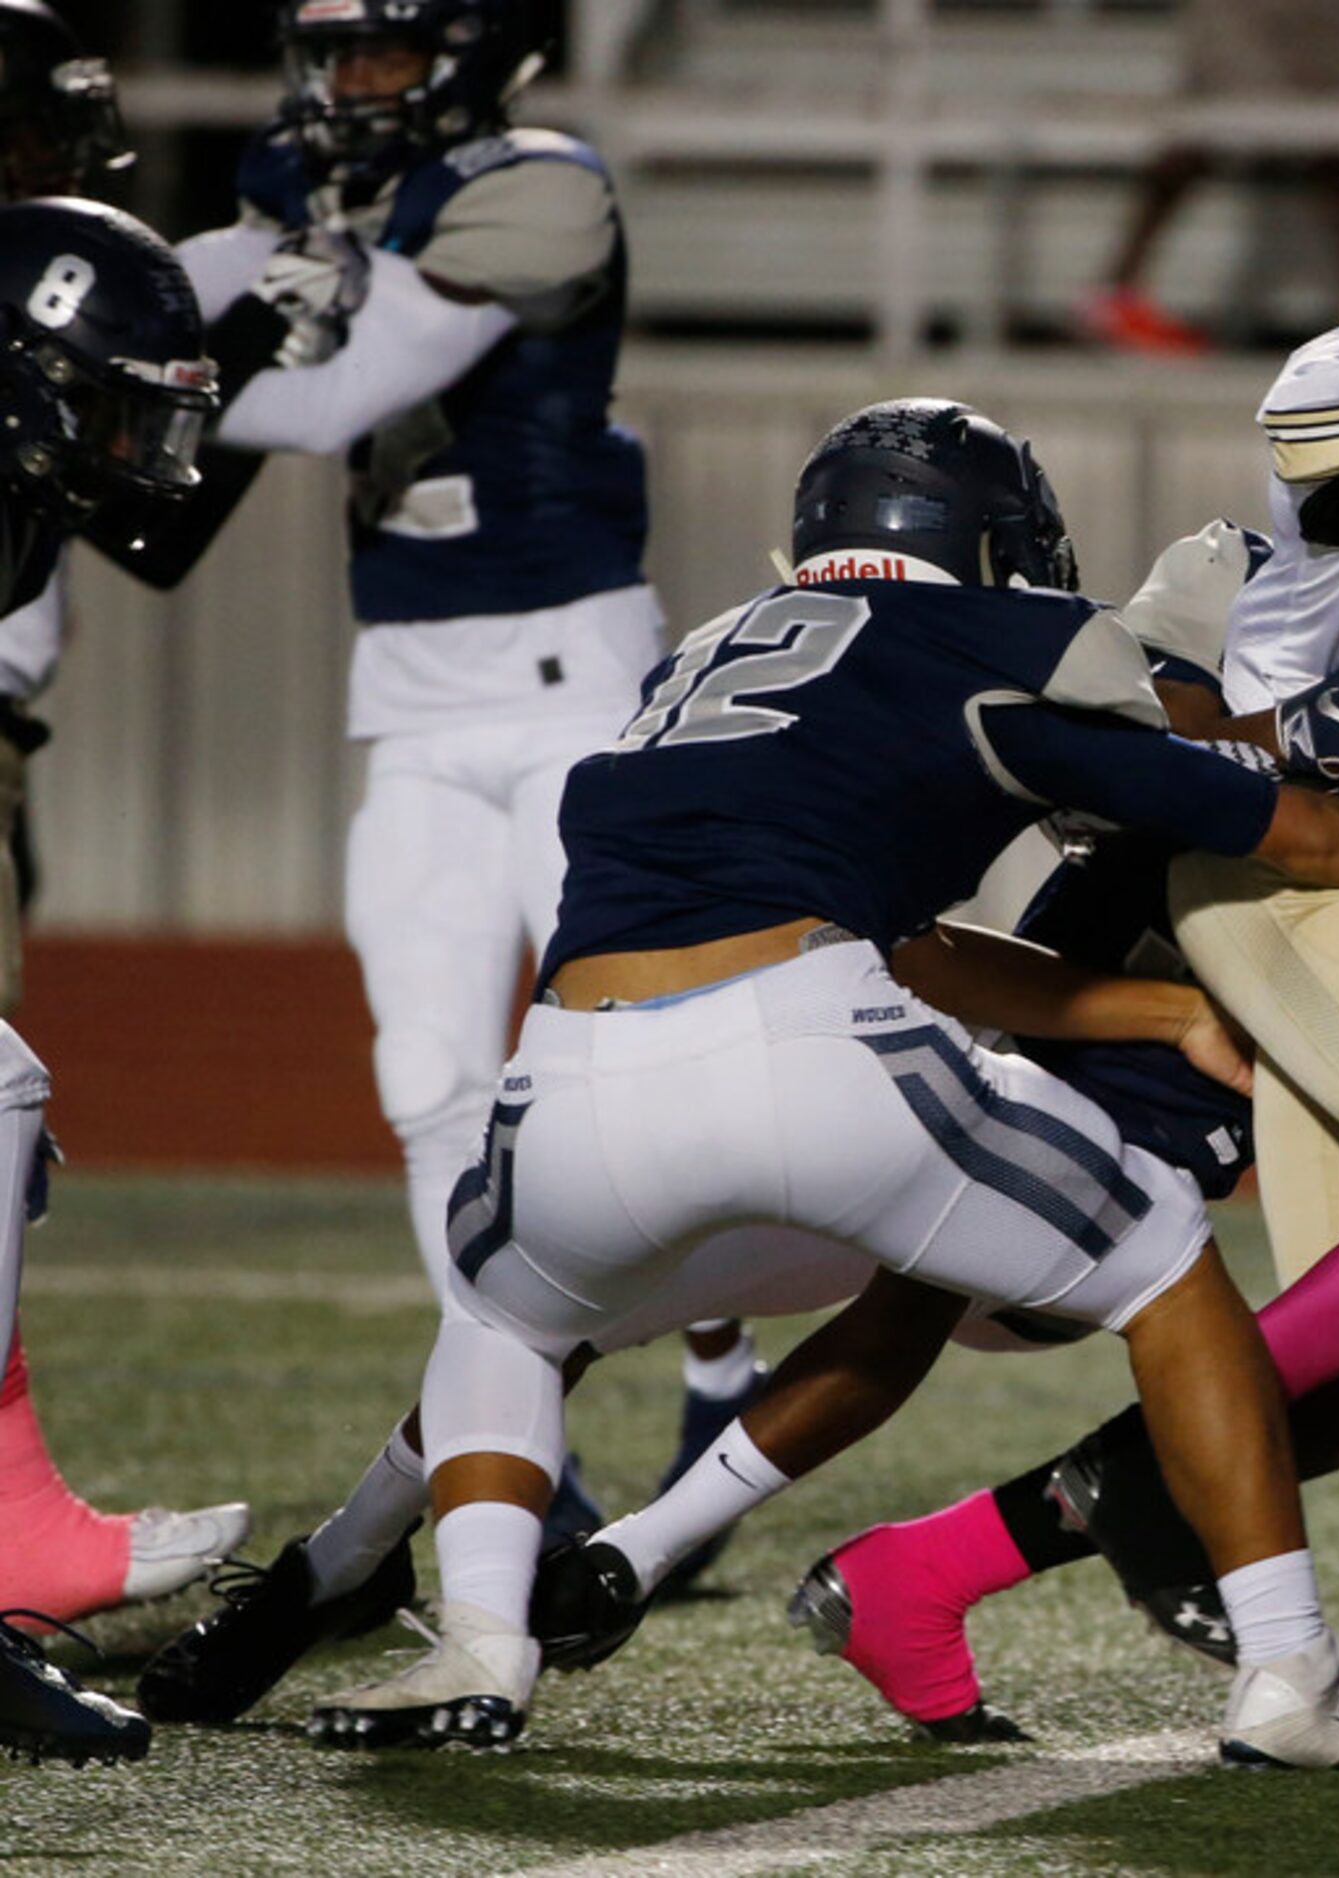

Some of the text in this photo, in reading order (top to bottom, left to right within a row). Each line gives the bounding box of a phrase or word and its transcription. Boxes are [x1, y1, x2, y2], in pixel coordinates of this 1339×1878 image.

[27, 253, 96, 330] 8
[615, 589, 872, 752] 12
[851, 1004, 906, 1024] WOLVES
